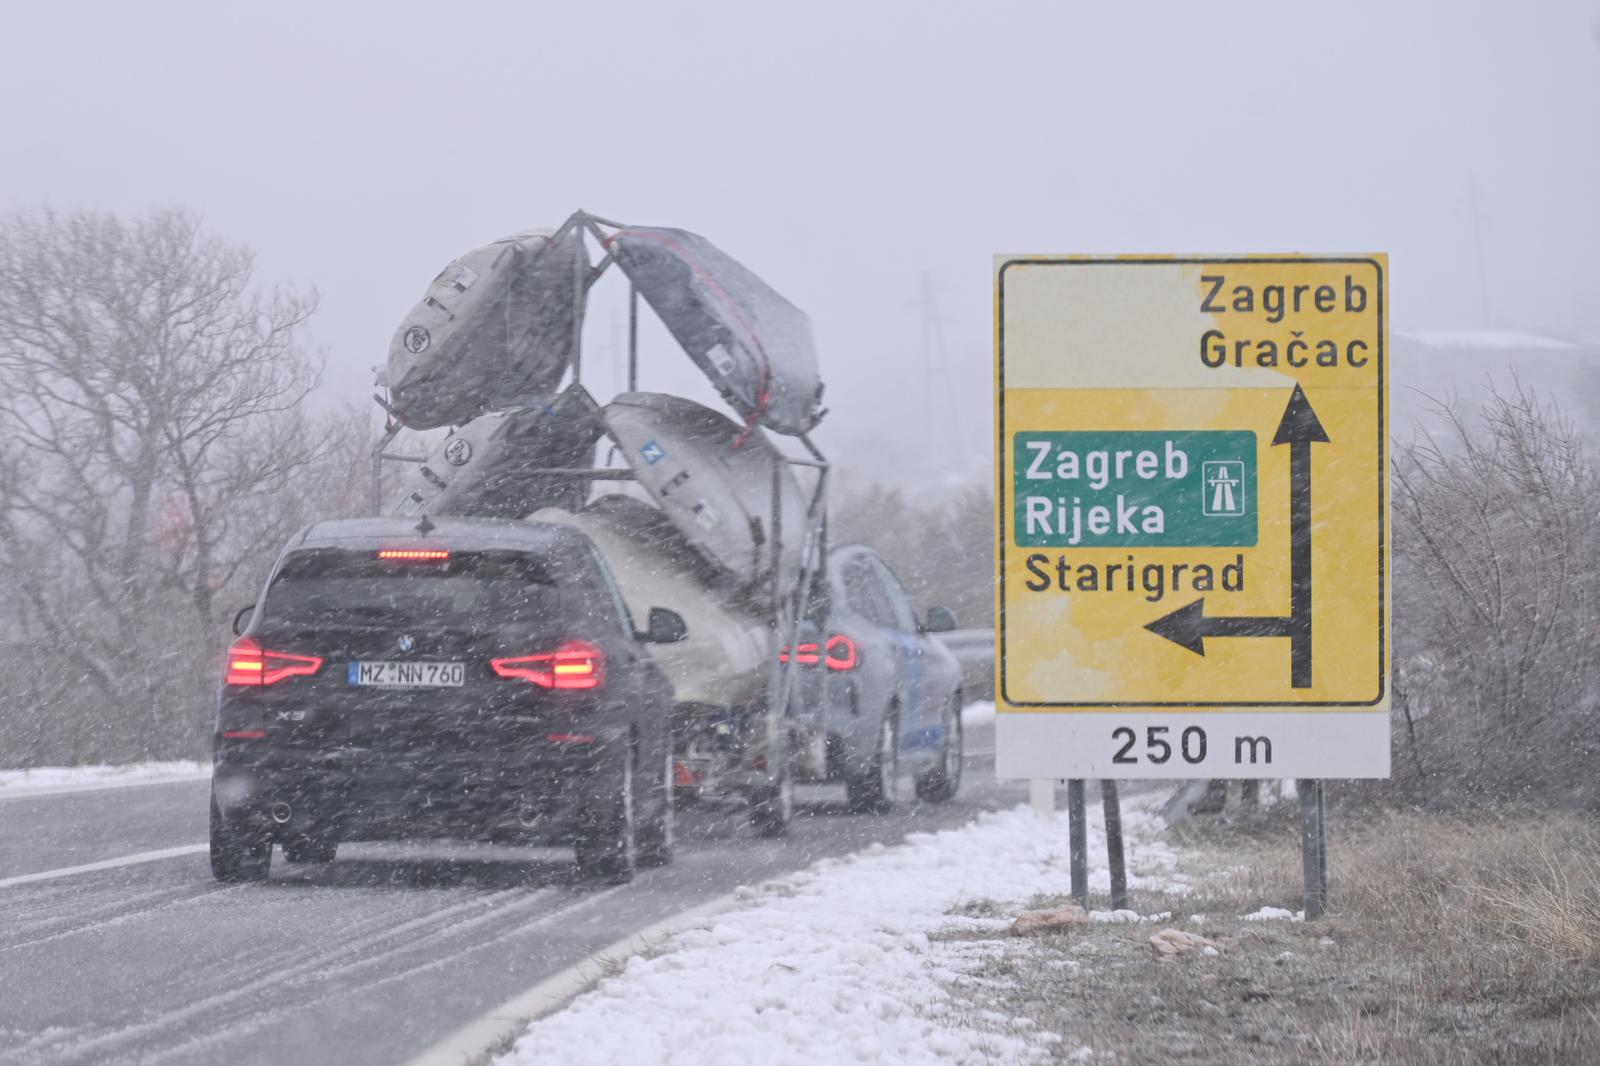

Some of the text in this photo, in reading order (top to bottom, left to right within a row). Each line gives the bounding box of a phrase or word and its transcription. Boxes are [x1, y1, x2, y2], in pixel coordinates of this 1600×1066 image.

[1200, 275, 1367, 323] Zagreb
[1200, 330, 1369, 368] Gračac
[1025, 441, 1188, 490] Zagreb
[1025, 495, 1165, 544] Rijeka
[1025, 553, 1244, 602] Starigrad
[360, 663, 462, 683] MZ NN 760
[1111, 726, 1272, 765] 250 m
